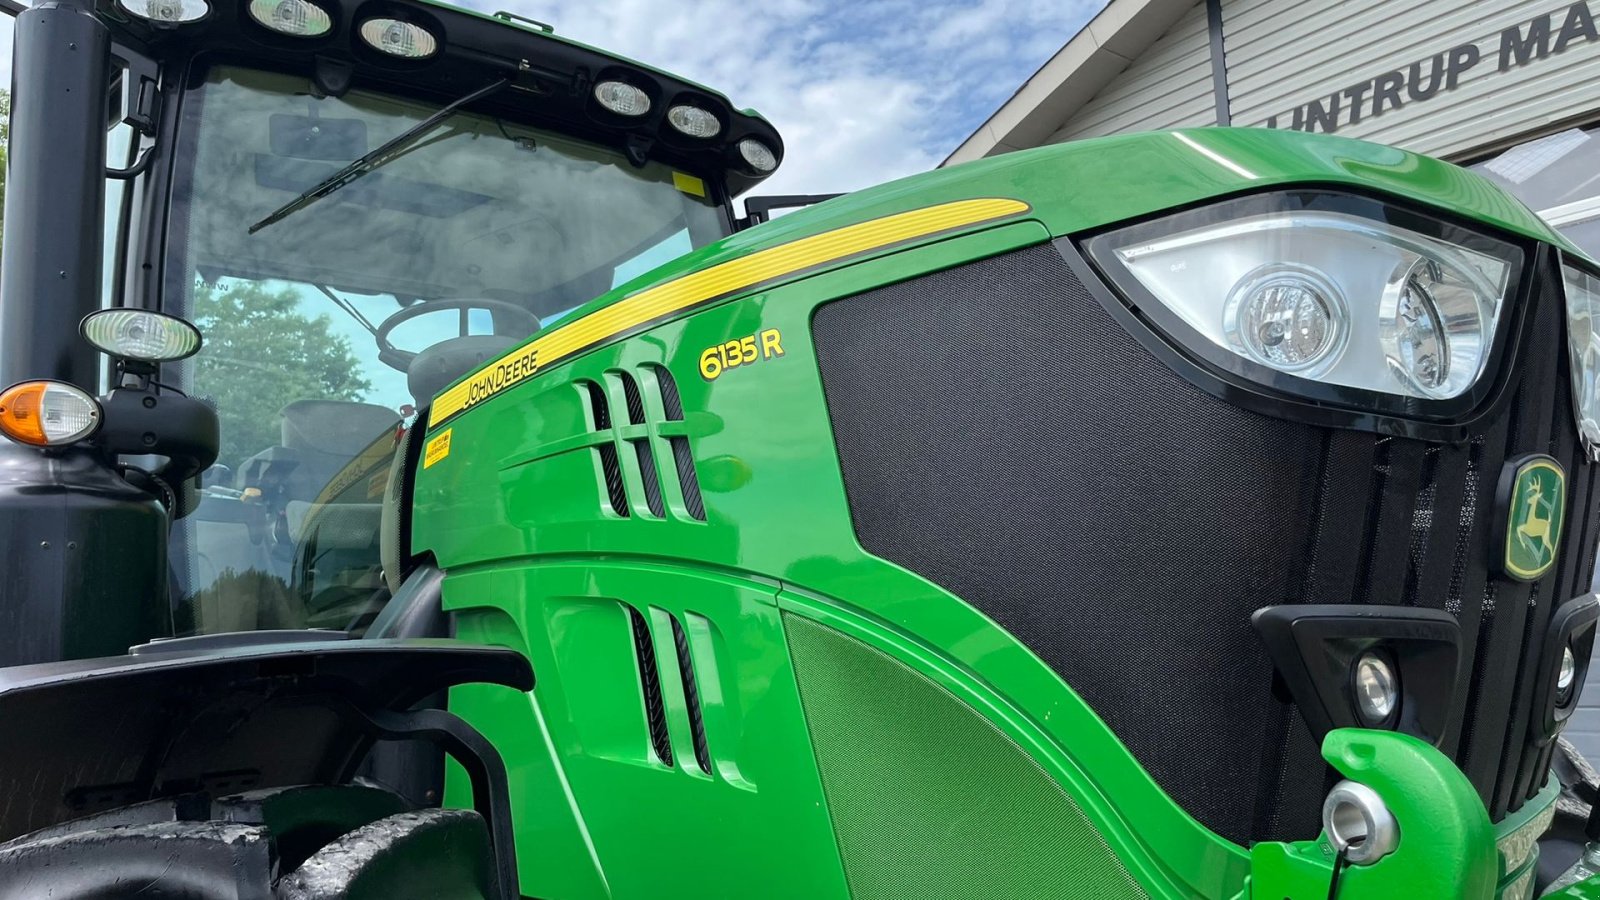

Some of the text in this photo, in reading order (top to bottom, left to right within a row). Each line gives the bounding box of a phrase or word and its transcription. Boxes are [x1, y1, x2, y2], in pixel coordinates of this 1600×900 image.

[464, 350, 539, 406] JOHN DEERE
[698, 327, 785, 380] 6135 R
